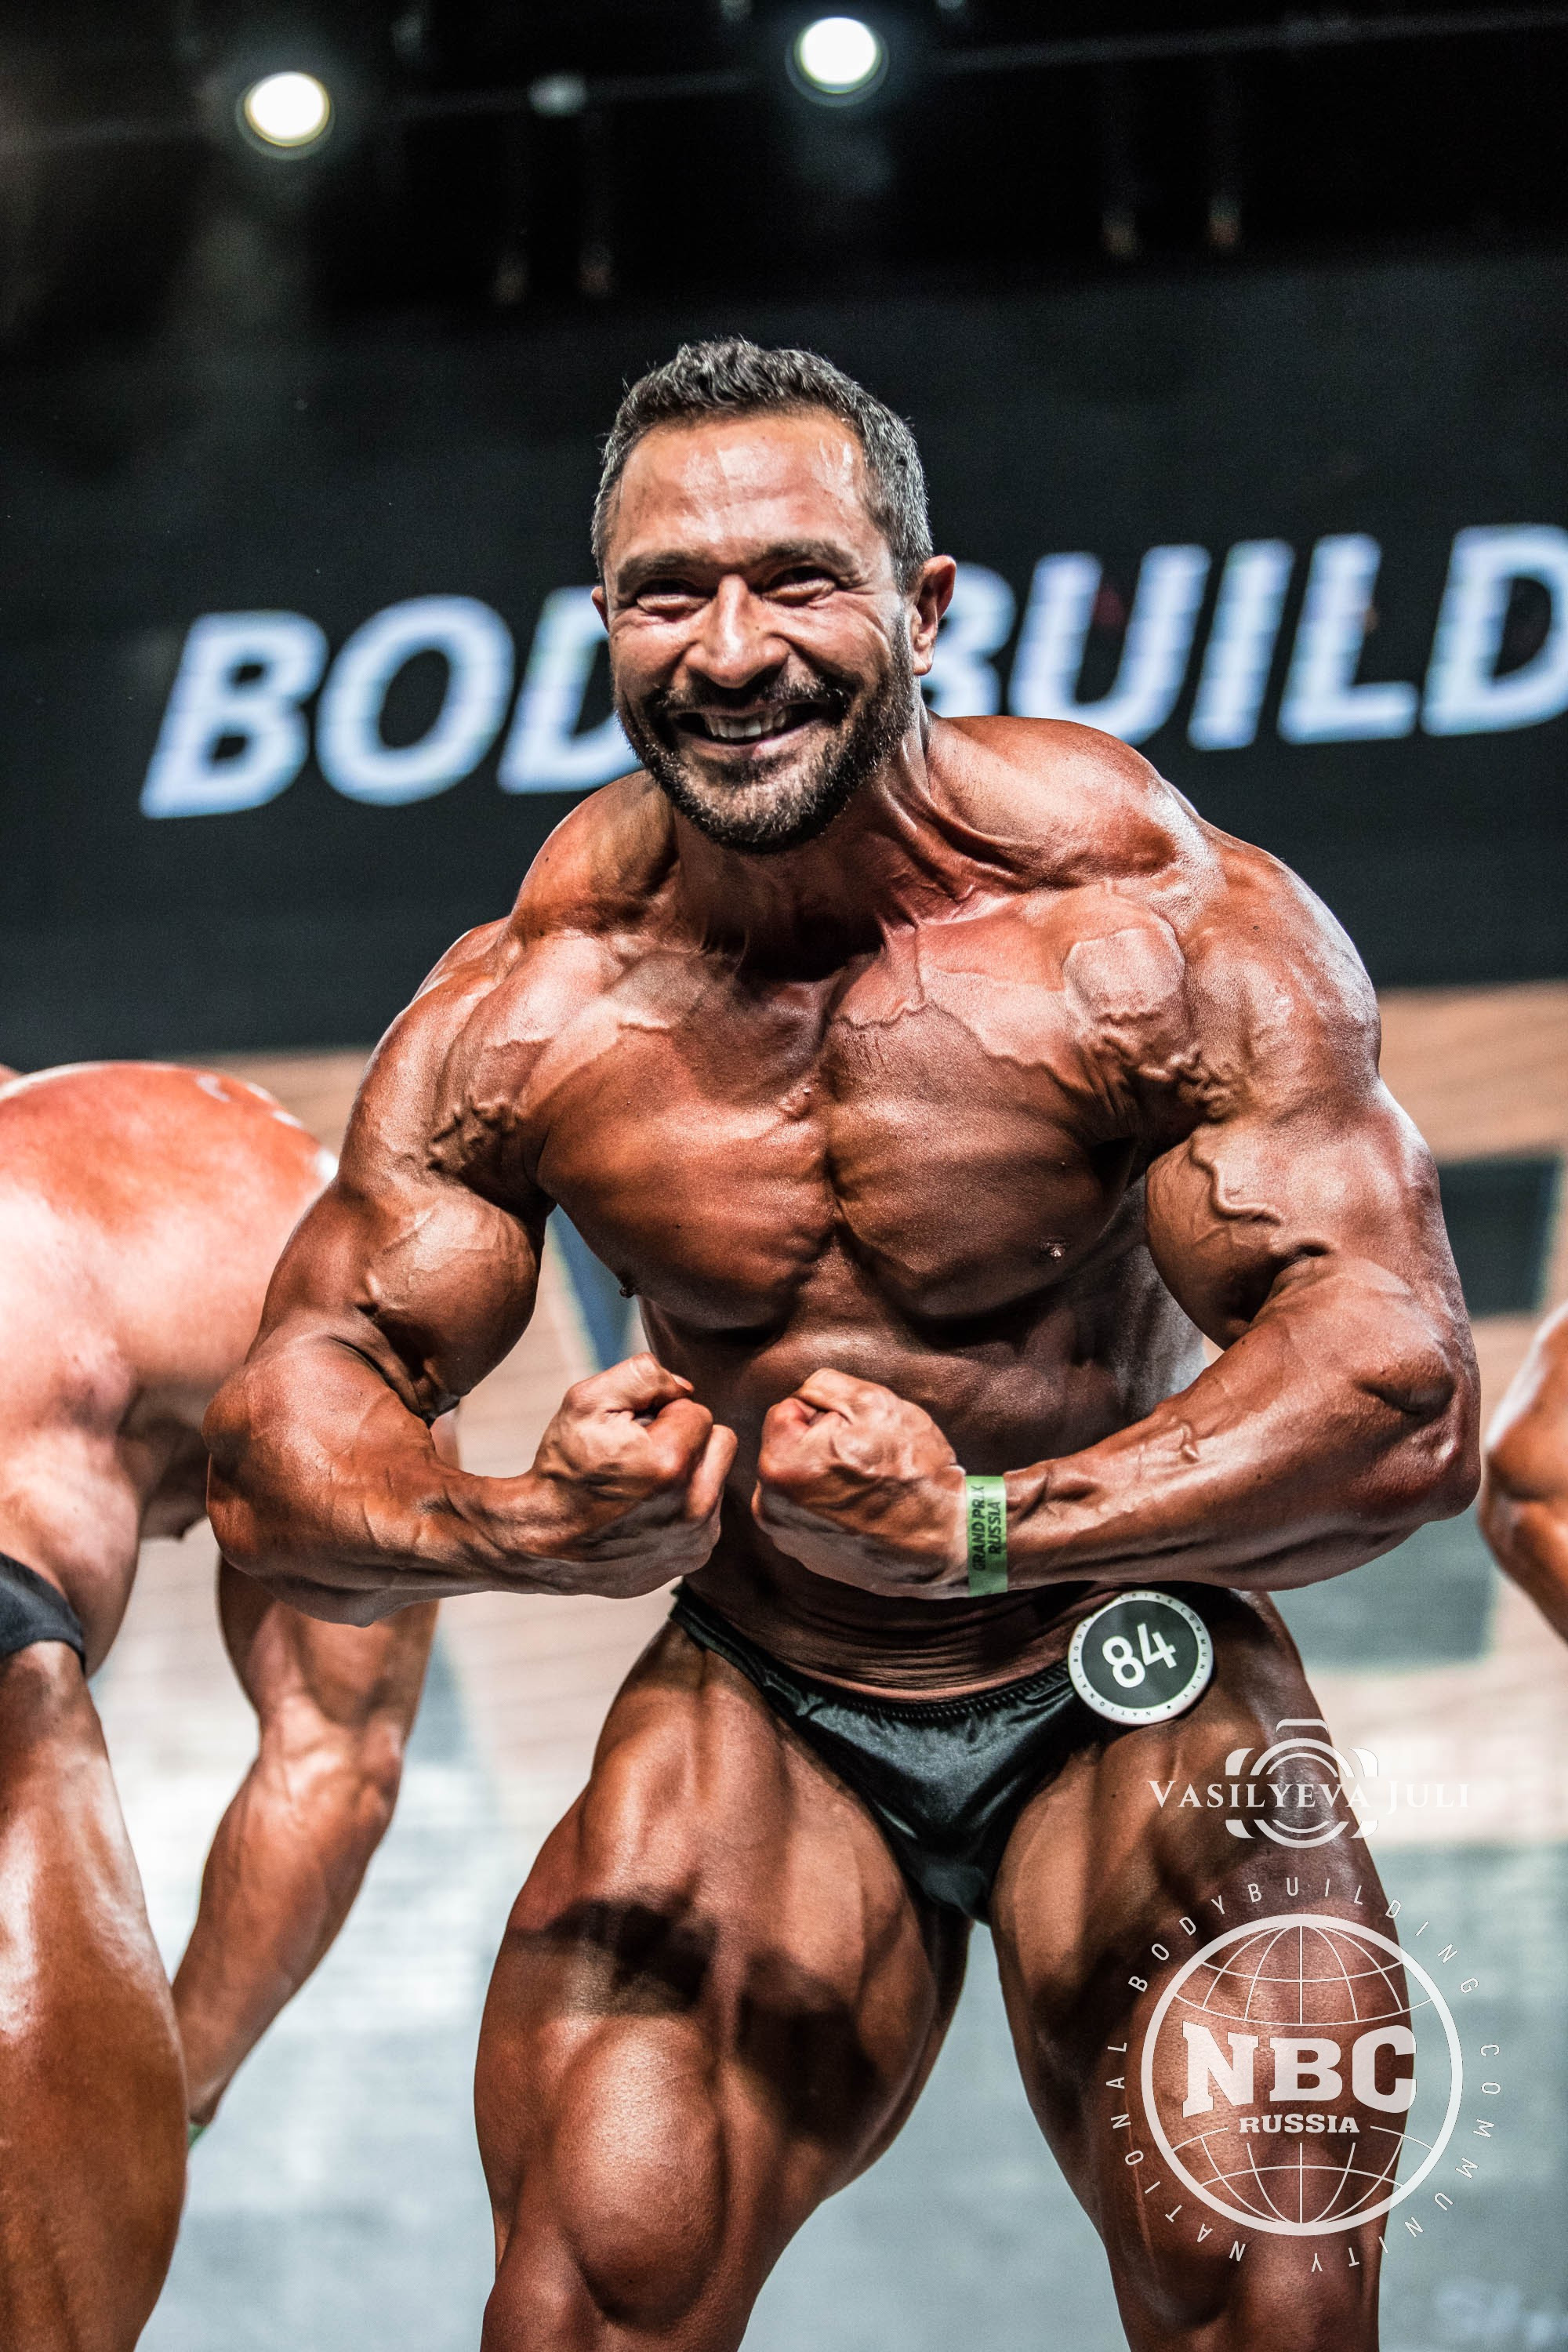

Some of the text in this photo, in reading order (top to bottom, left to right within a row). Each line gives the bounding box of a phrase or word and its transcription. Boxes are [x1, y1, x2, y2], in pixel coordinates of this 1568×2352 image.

[971, 1485, 985, 1571] GRAND PRIX
[988, 1501, 1001, 1555] RUSSIA
[1078, 1675, 1152, 1716] NATIONAL
[1180, 1607, 1208, 1698] COMMUNITY
[1102, 1623, 1177, 1688] 84
